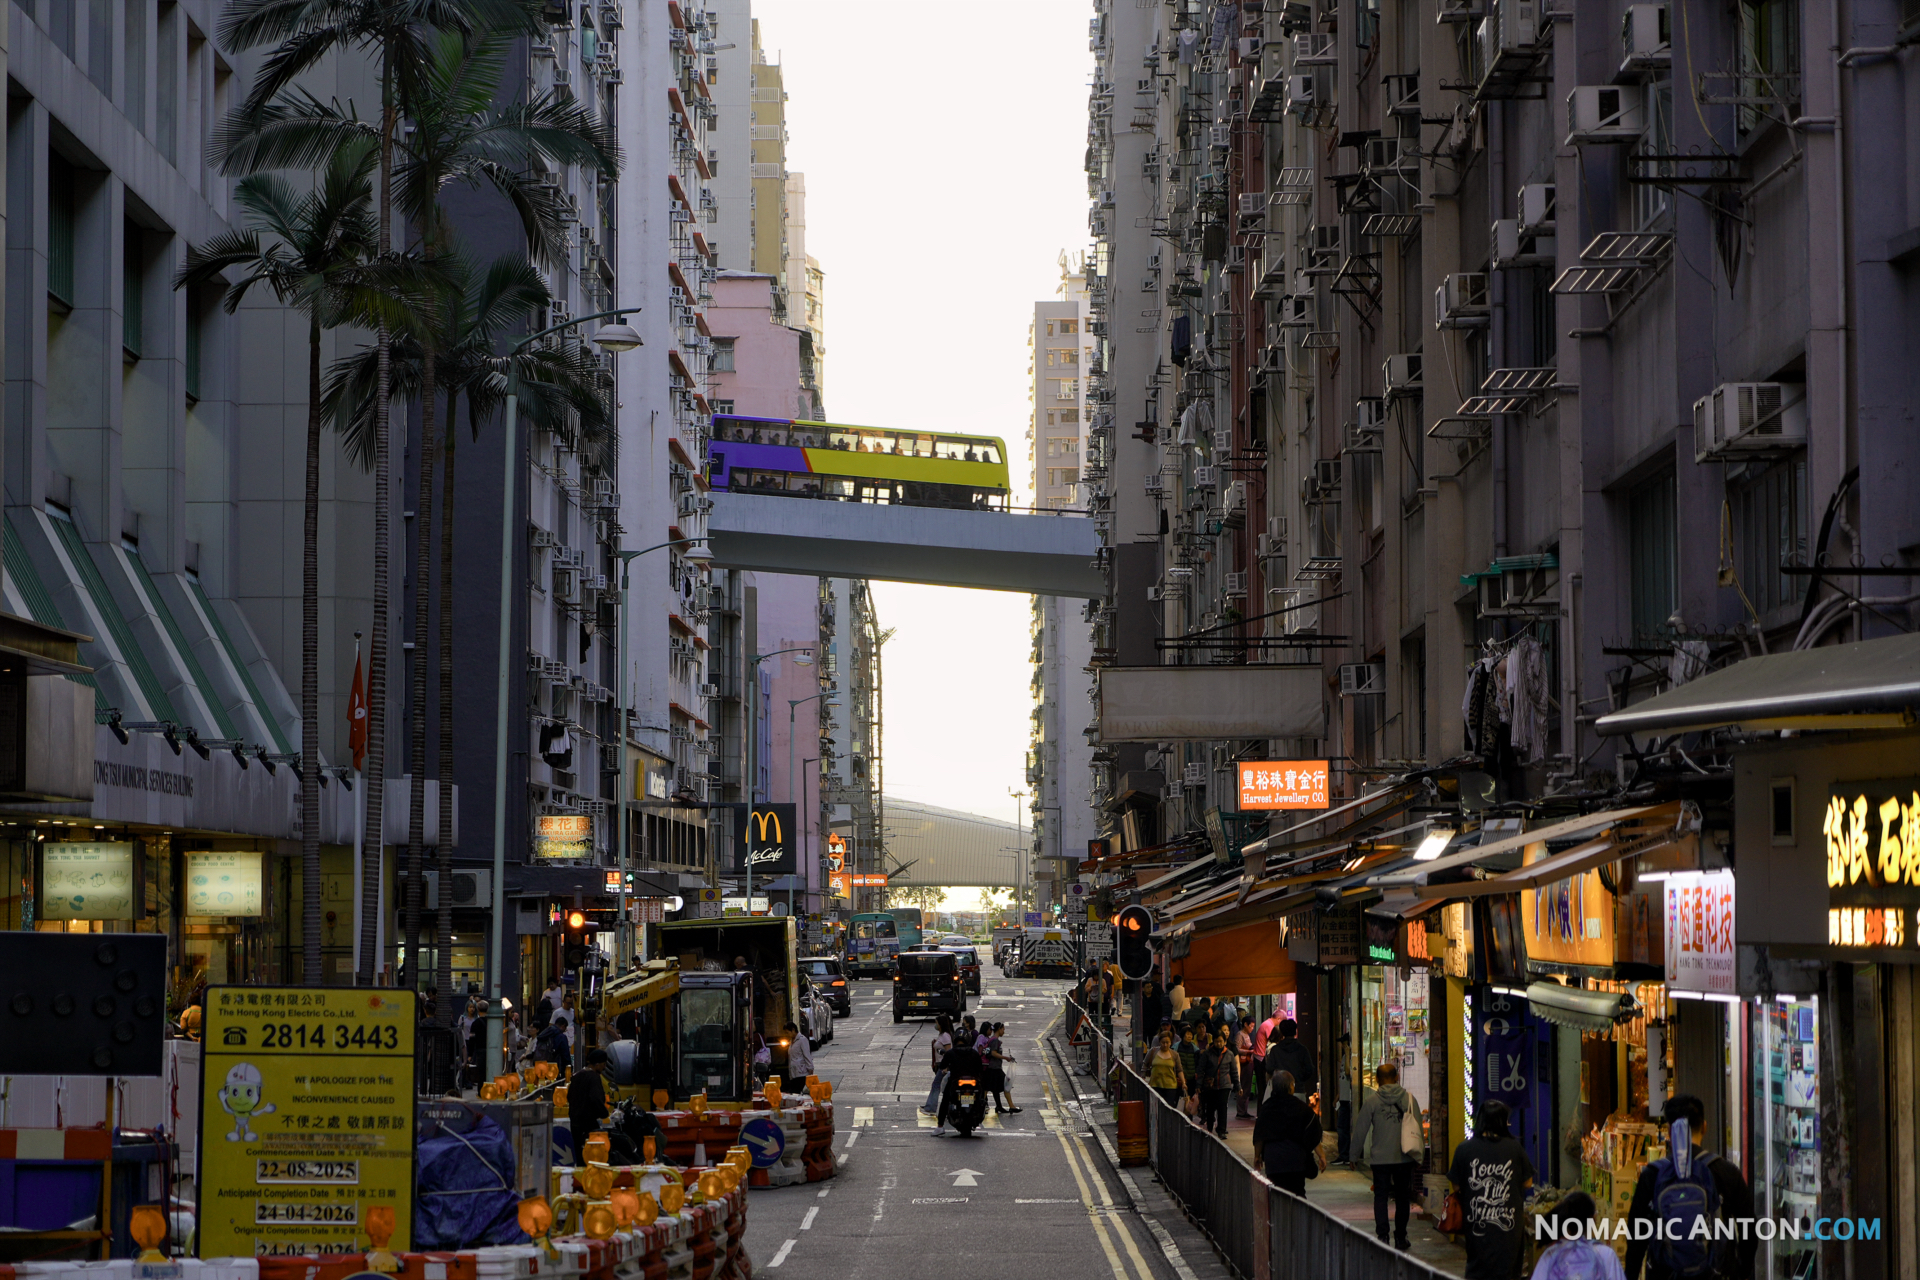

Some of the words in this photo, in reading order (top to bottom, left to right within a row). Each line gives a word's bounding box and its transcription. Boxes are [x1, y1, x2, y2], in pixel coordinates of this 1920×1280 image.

[122, 764, 148, 791] MUNICIPAL
[149, 769, 172, 794] SERVICES
[173, 773, 194, 798] BUILDING
[1242, 769, 1326, 791] 豐裕珠寶金行
[1243, 792, 1272, 804] Harvest
[1274, 792, 1310, 805] Jewellery
[1312, 792, 1326, 803] CO.
[539, 817, 590, 830] 櫻花園
[220, 994, 326, 1006] 香港電燈有限公司
[618, 991, 648, 1008] YANMAR
[218, 1008, 236, 1016] The
[237, 1009, 259, 1018] Hong
[262, 1009, 286, 1018] Kong
[288, 1010, 320, 1018] Electric
[261, 1024, 326, 1048] 2814
[335, 1024, 399, 1049] 3443
[295, 1076, 308, 1084] WE
[310, 1076, 357, 1084] APOLOGIZE
[359, 1076, 376, 1084] FOR
[378, 1076, 394, 1084] THE
[292, 1096, 359, 1104] INCONVENIENCE
[361, 1096, 395, 1104] CAUSED
[282, 1115, 340, 1129] 不便之處
[347, 1116, 405, 1130] 敬請原諒
[246, 1148, 314, 1156] Commencement
[259, 1162, 355, 1178] 22-08-2025
[1468, 1158, 1513, 1186] Lovely
[218, 1188, 262, 1200] Anticipated
[264, 1189, 308, 1200] Completion
[310, 1190, 329, 1198] Date
[336, 1189, 396, 1198] 預計竣工日期
[1477, 1180, 1511, 1204] Little
[258, 1205, 354, 1221] 24-04-2026
[1467, 1196, 1515, 1224] Princess
[234, 1226, 264, 1236] Original
[266, 1227, 310, 1236] Completion
